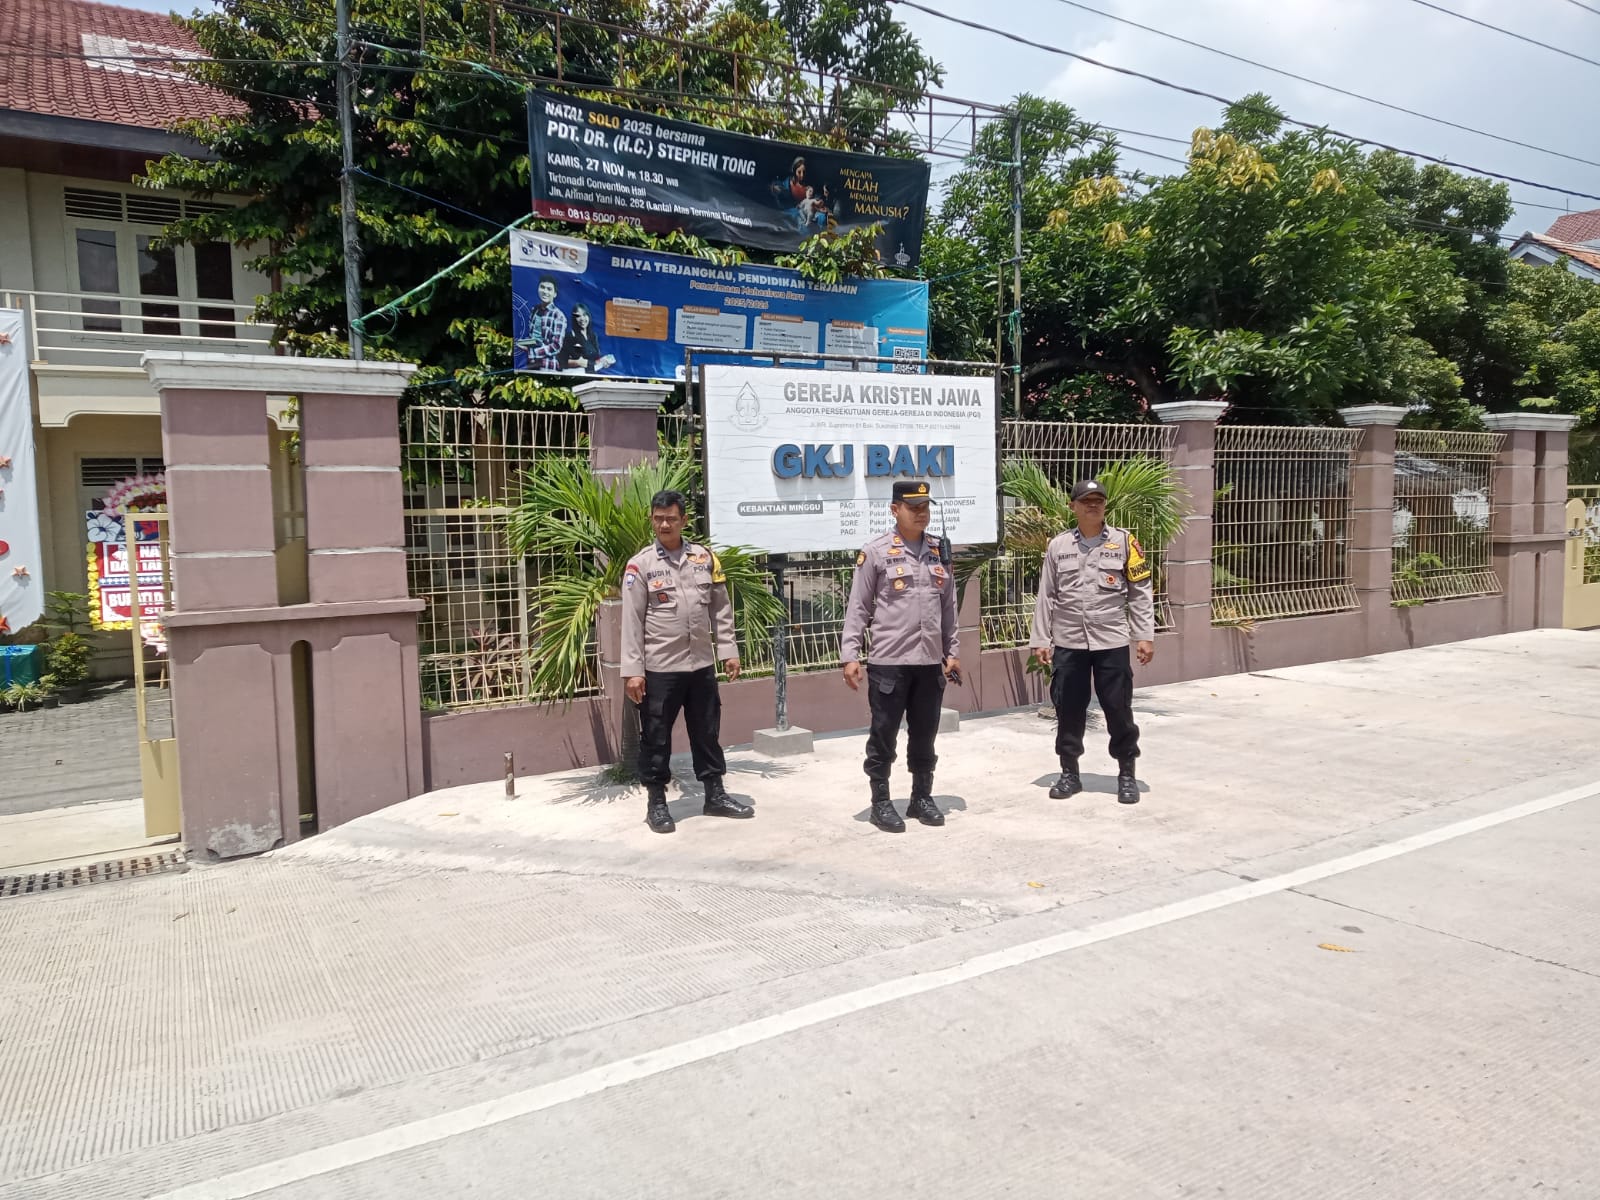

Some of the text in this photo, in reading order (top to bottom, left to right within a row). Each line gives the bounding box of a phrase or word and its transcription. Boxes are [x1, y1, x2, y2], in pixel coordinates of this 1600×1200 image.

[545, 101, 706, 147] NATAL SOLO 2025 bersama
[547, 120, 757, 177] PDT. DR. (H.C.) STEPHEN TONG
[547, 152, 584, 171] KAMIS,
[586, 157, 599, 172] 27
[602, 161, 625, 177] NOV
[639, 170, 664, 185] 18.30
[666, 177, 679, 187] WIB
[840, 168, 872, 179] MENGAPA
[548, 171, 647, 197] Tirtonadi Convention Hall
[844, 178, 878, 193] ALLAH
[565, 188, 594, 202] Ahmad
[595, 193, 613, 204] Yani
[615, 197, 628, 207] No.
[630, 198, 645, 209] 262
[690, 206, 721, 220] Terminal
[849, 191, 879, 203] MENJADI
[567, 208, 590, 220] 0813
[854, 202, 910, 220] MANUSIA?
[539, 244, 578, 261] UKTS
[611, 256, 858, 295] BIAYA TERJANGKAU, PENDIDIKAN TERJAMIN
[690, 280, 740, 295] Penerimaan
[741, 285, 785, 299] Mahasiswa
[784, 382, 981, 407] GEREJA KRISTEN JAWA
[786, 407, 820, 415] ANGGOTA
[822, 408, 871, 416] PERSEKUTUAN
[872, 409, 924, 418] GEREJA-GEREJA
[933, 410, 966, 418] INDONESIA
[967, 411, 981, 420] (PGI)
[772, 443, 955, 478] GKJ BAKI
[740, 503, 821, 513] KEBAKTIAN MINGGU
